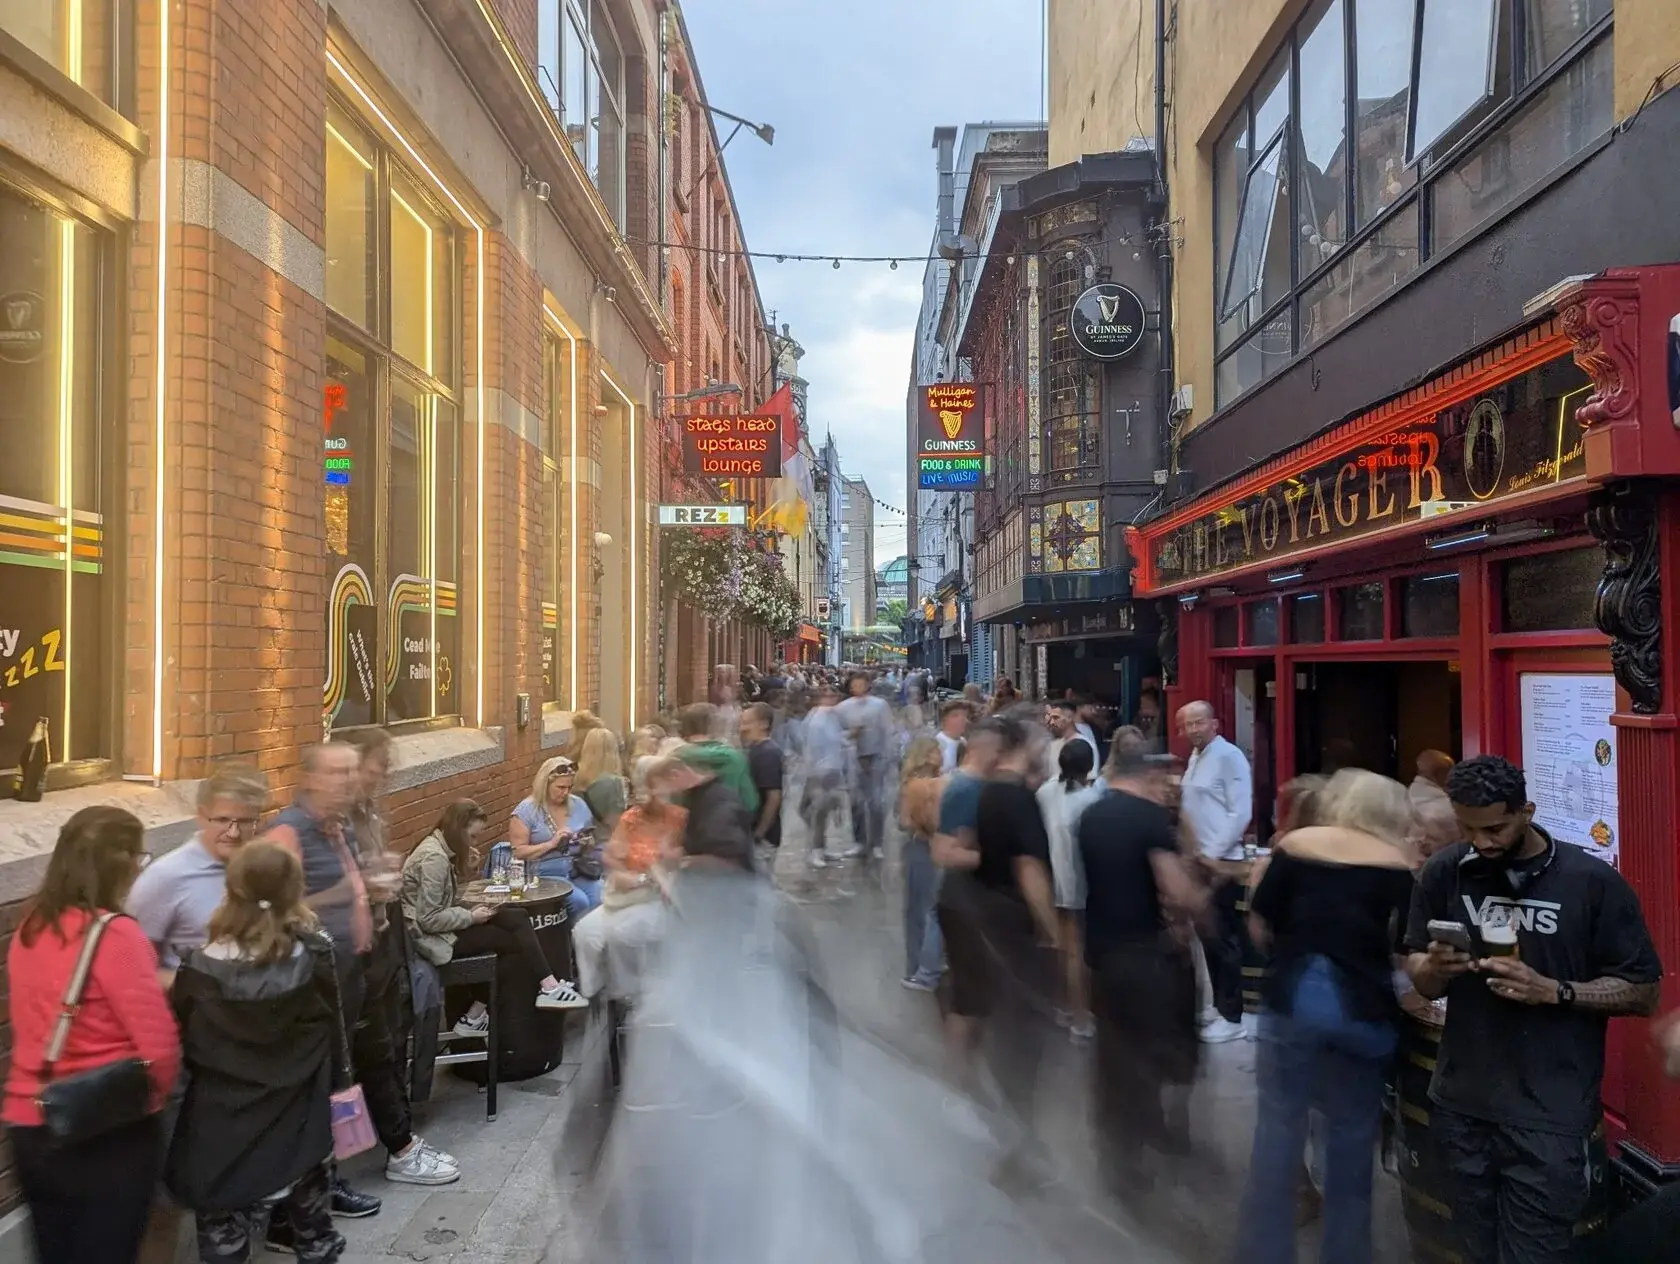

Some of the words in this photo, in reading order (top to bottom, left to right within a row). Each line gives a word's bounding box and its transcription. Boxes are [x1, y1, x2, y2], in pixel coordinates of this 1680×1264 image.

[1085, 324, 1132, 334] GUINNESS
[928, 385, 976, 399] Mulligan
[929, 399, 939, 408] &
[940, 398, 975, 408] Haines
[686, 417, 731, 434] stags
[737, 416, 776, 432] head
[697, 437, 767, 454] upstairs
[924, 439, 976, 451] GUINNESS
[703, 457, 762, 475] lounge
[921, 459, 944, 470] FOOD
[945, 460, 952, 470] &
[953, 459, 982, 470] DRINK
[921, 472, 944, 485] LIVE
[947, 471, 979, 485] MUSIC
[1238, 430, 1447, 556] VOYAGER
[404, 637, 424, 653] Cead
[1461, 894, 1562, 935] VANS
